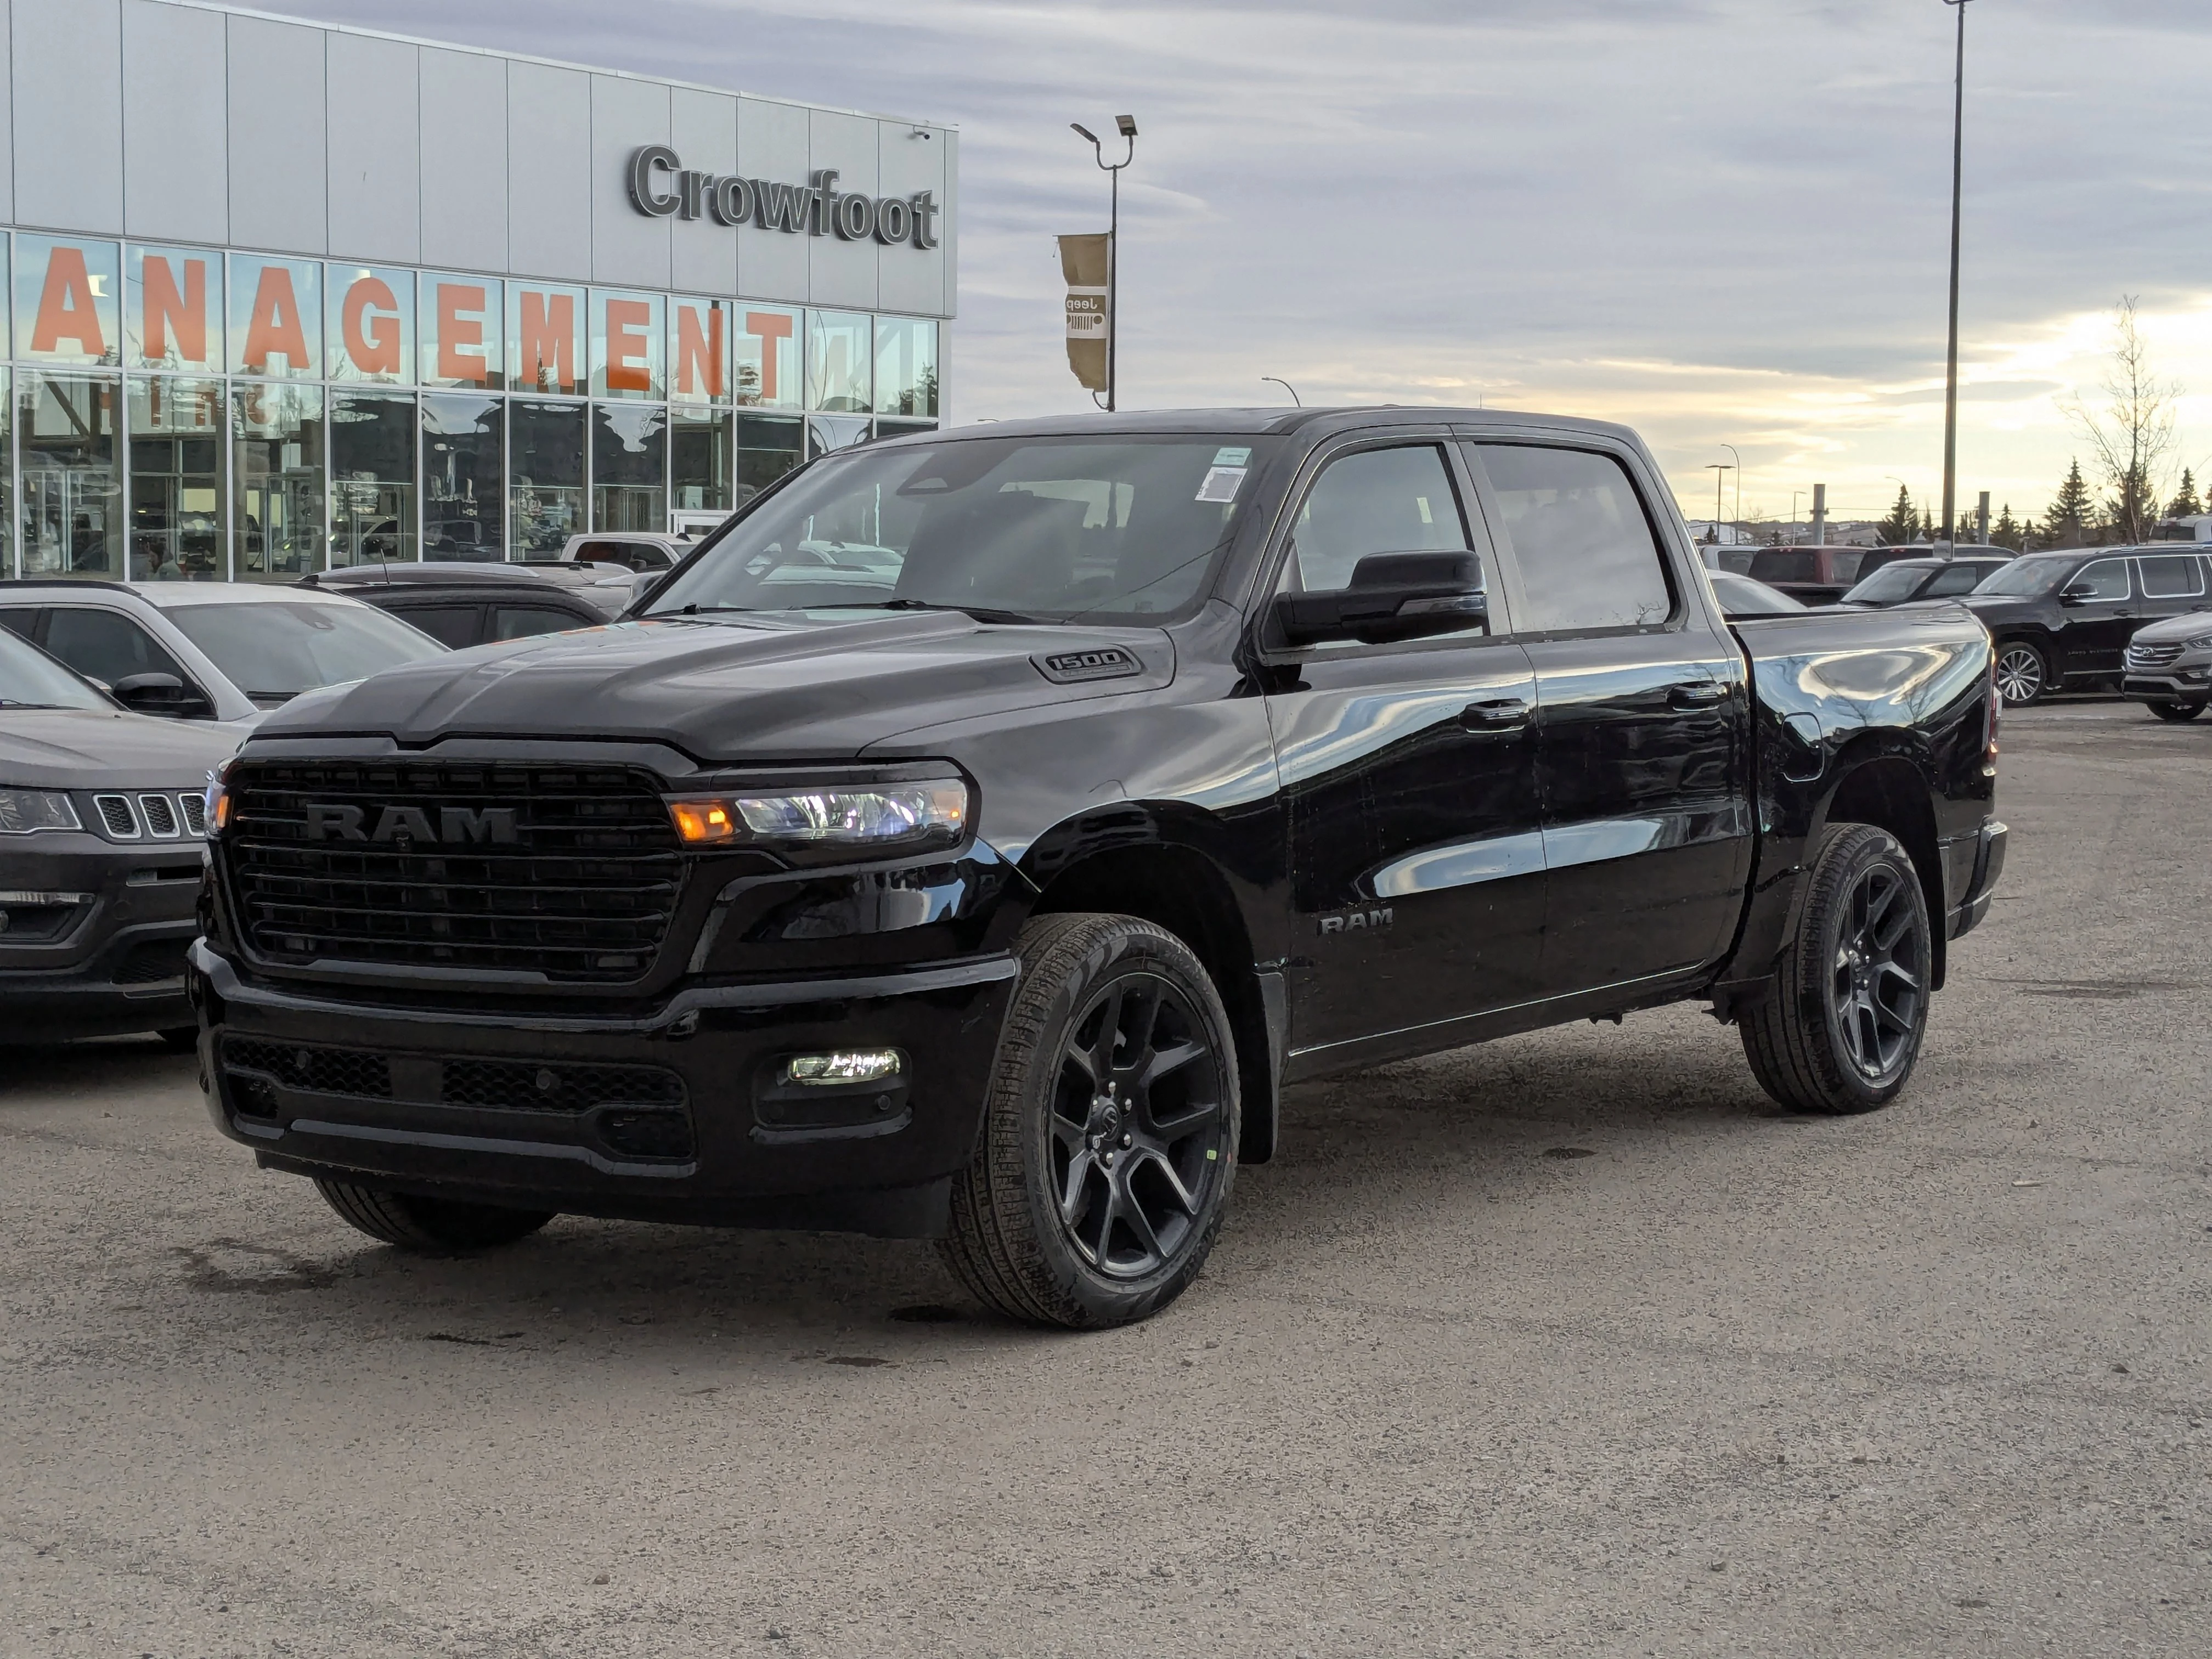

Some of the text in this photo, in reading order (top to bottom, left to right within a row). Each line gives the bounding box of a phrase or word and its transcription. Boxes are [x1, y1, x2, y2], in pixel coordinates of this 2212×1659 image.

[630, 144, 939, 250] Crowfoot
[1048, 651, 1121, 670] 1500
[306, 803, 518, 843] RAM
[1318, 907, 1394, 935] RAM
